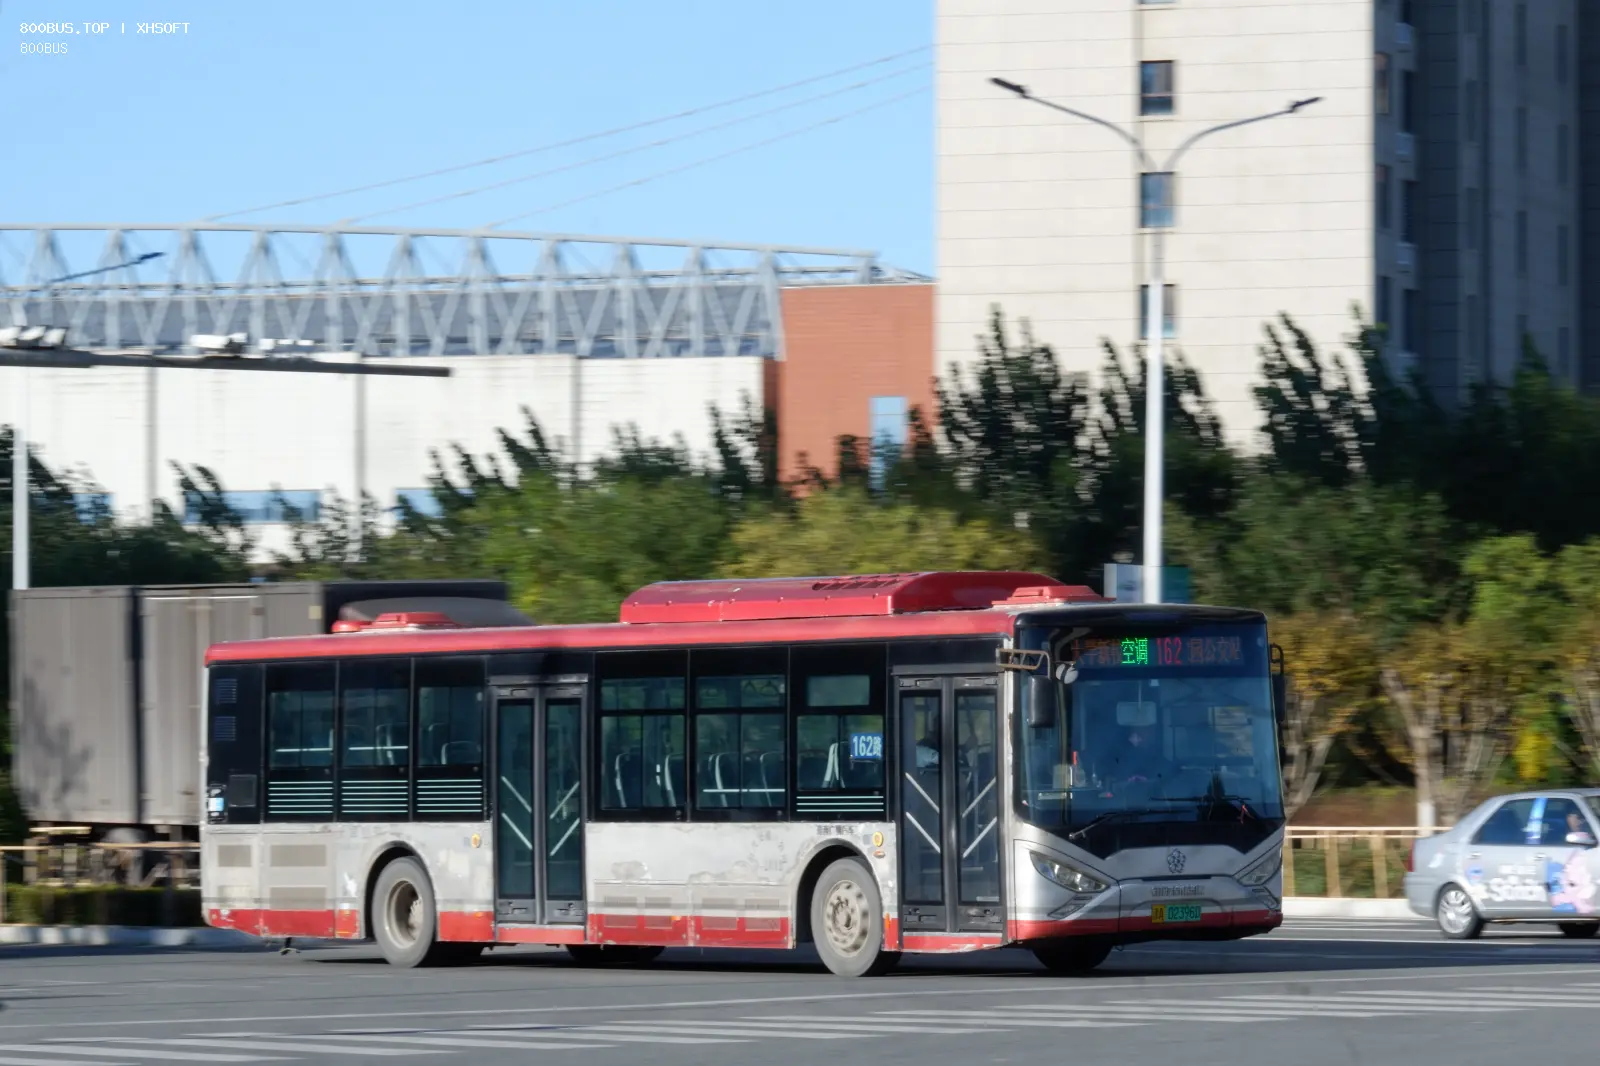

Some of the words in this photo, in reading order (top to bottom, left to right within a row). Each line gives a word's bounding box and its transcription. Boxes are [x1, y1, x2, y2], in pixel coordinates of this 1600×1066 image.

[1121, 637, 1148, 665] 空调
[1156, 637, 1183, 665] 162
[852, 735, 882, 757] 162路
